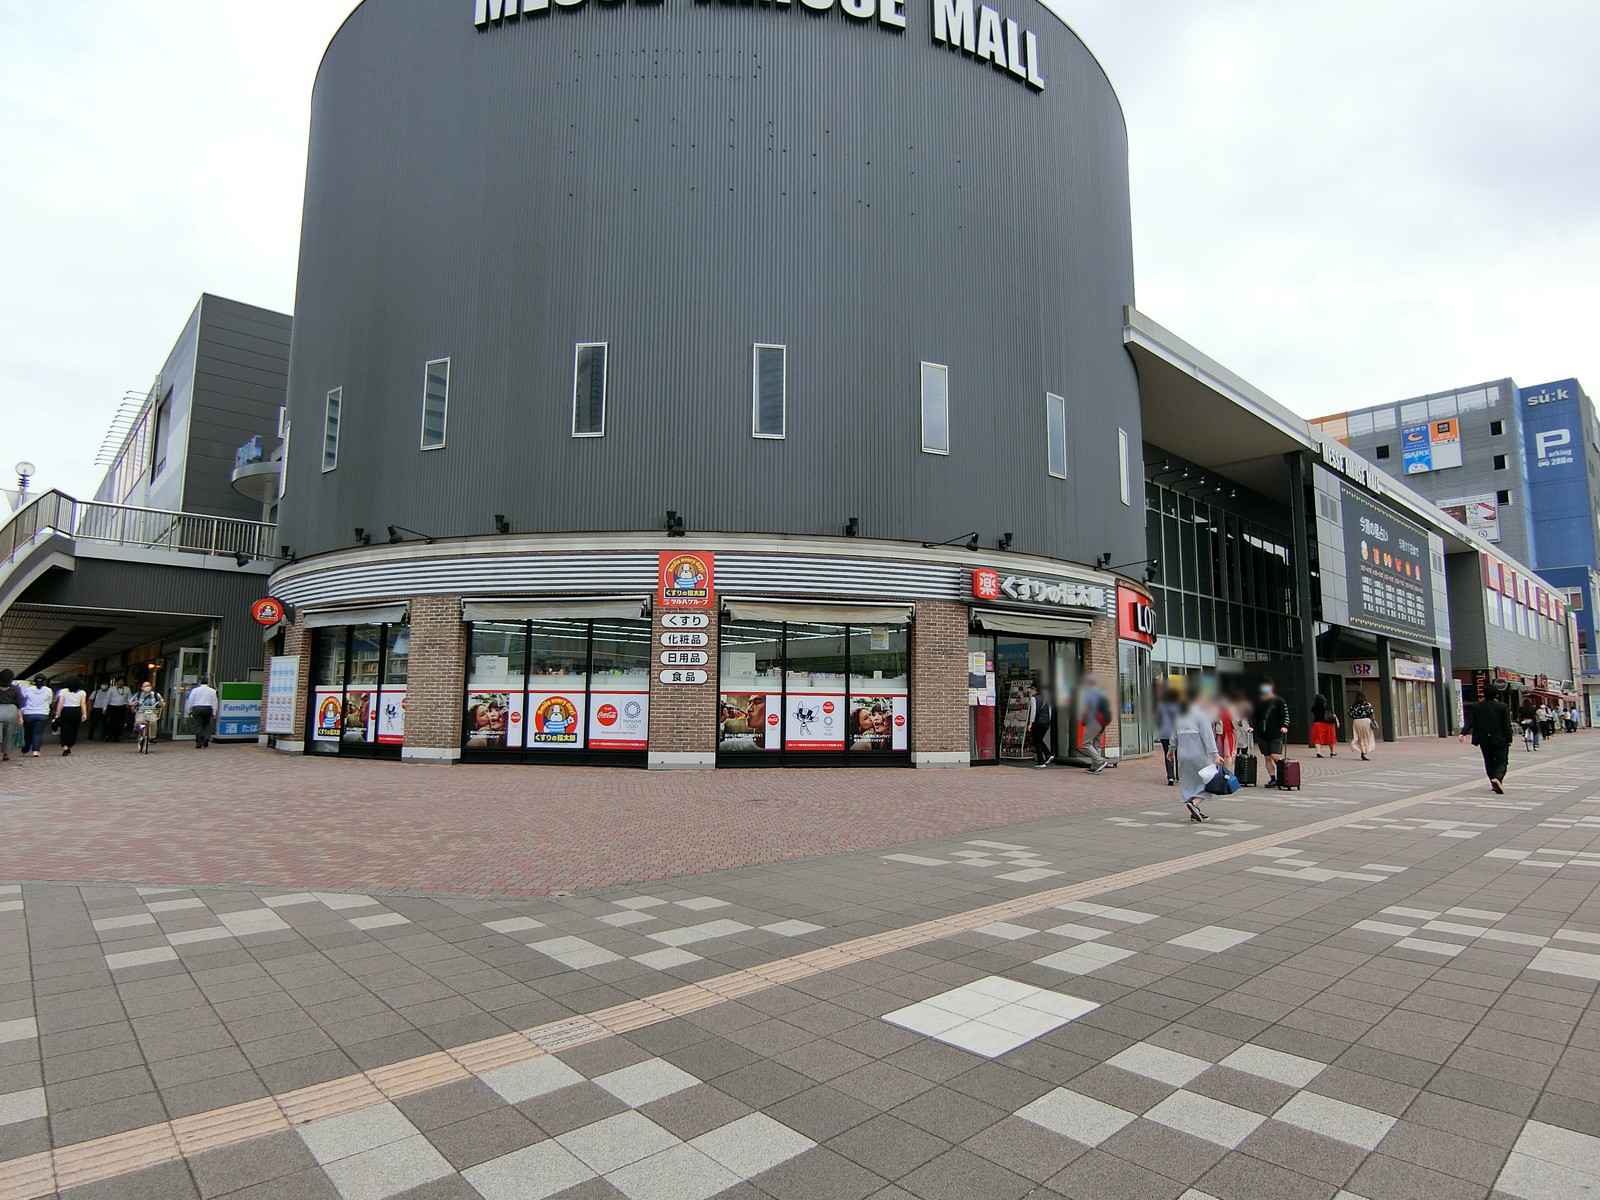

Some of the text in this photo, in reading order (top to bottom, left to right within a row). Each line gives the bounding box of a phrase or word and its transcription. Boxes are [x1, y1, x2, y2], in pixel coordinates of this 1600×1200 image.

[1535, 428, 1571, 459] P
[1403, 449, 1430, 459] SAPIX
[979, 572, 997, 596] 薬
[1000, 576, 1105, 608] くすりの福太郎
[669, 615, 701, 626] くすり
[668, 634, 701, 645] 化粧品
[668, 653, 700, 663] 日用品
[1352, 663, 1371, 675] BR
[672, 671, 696, 682] 食品
[225, 722, 238, 734] 酒
[534, 734, 576, 742] くすりの福太郎
